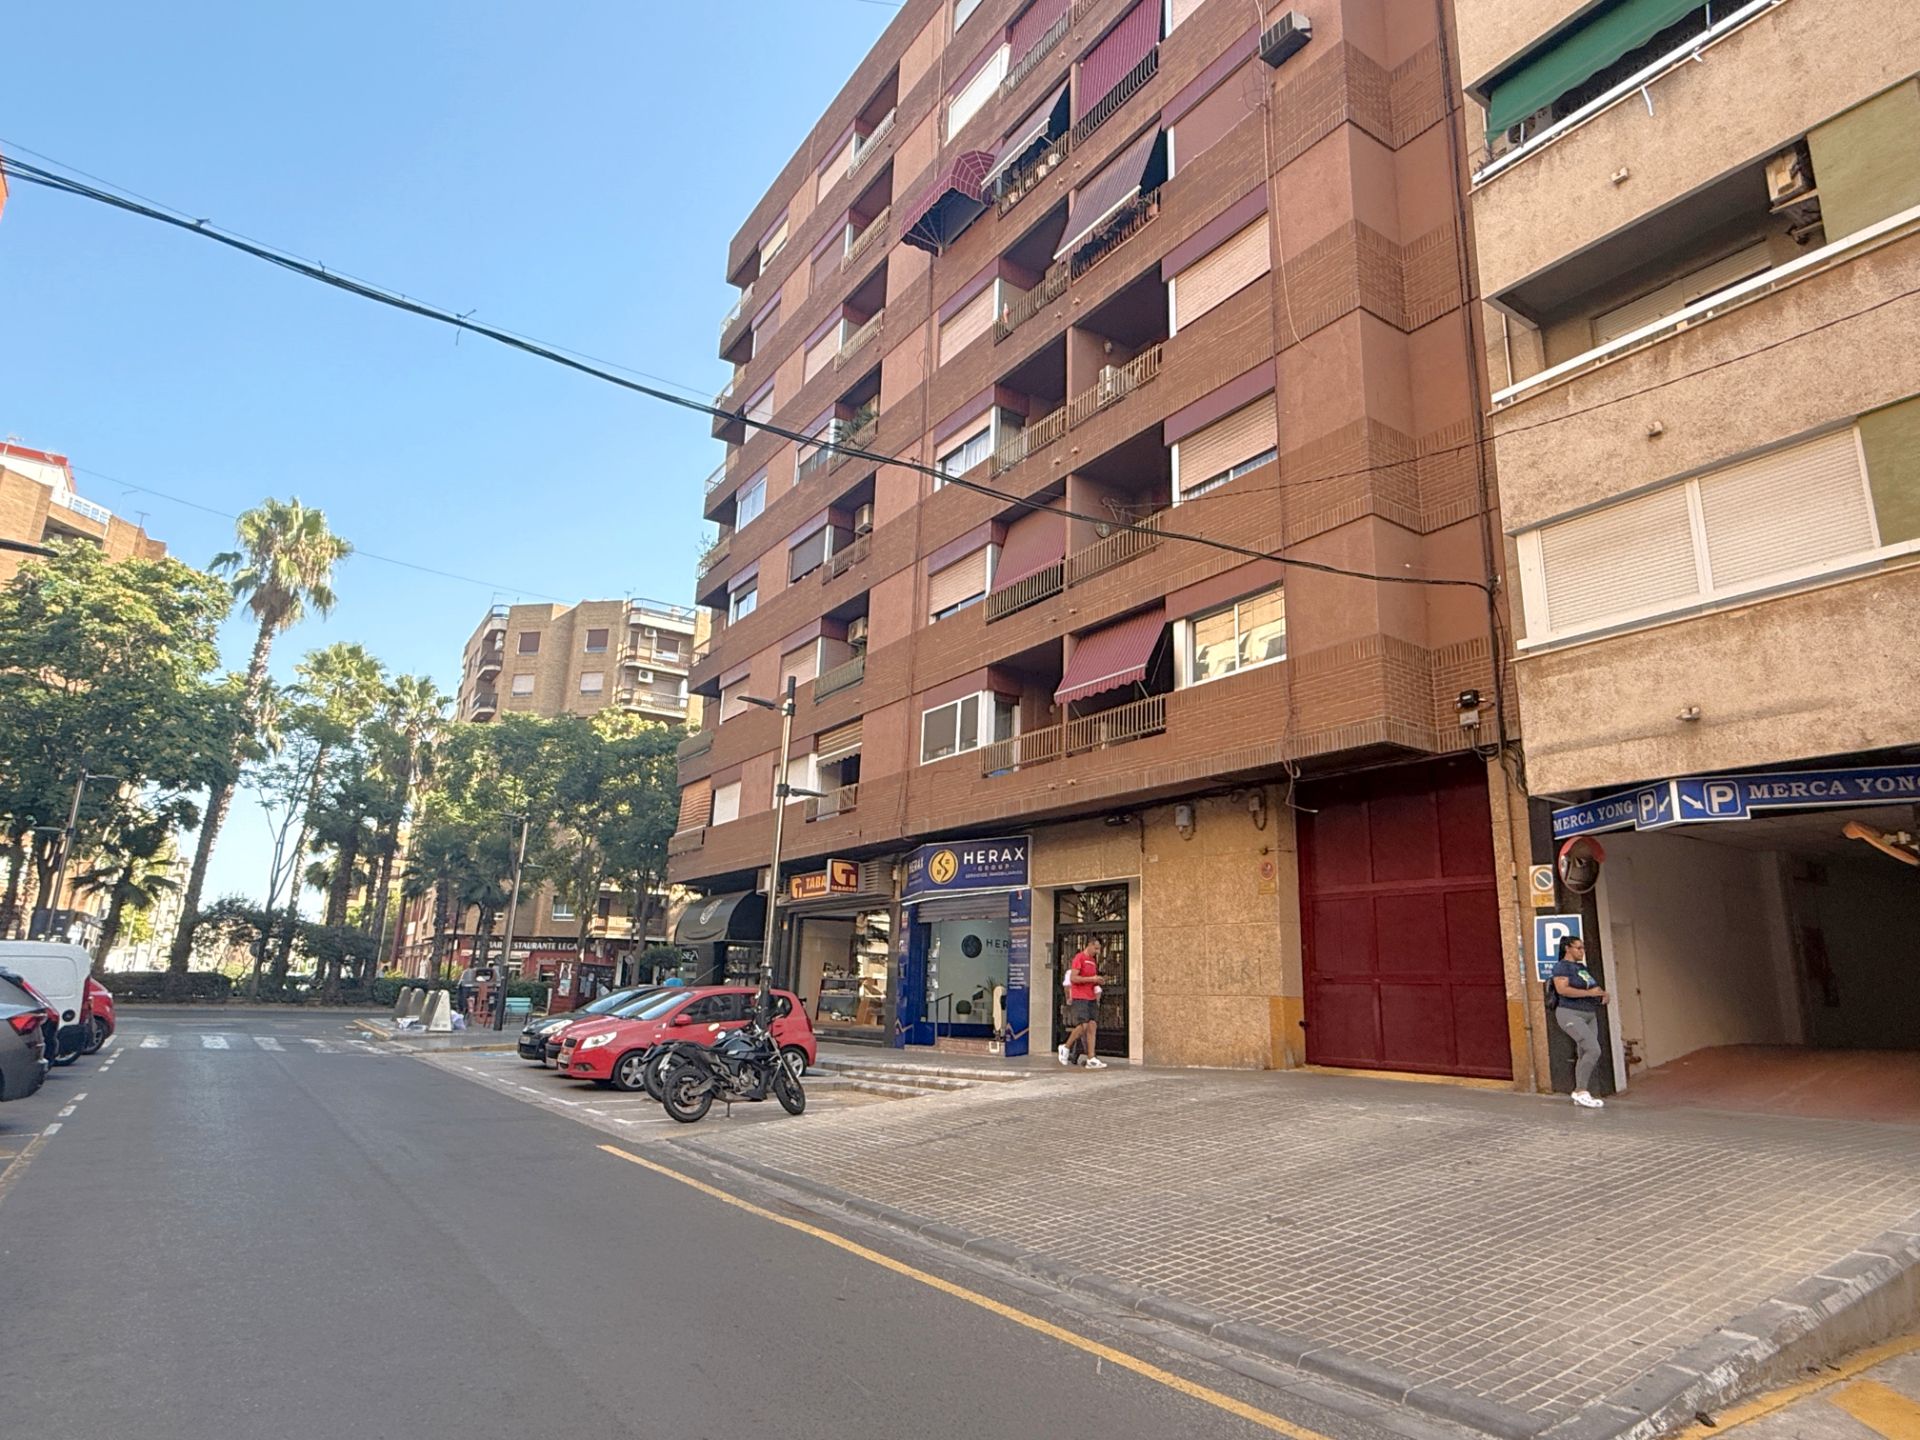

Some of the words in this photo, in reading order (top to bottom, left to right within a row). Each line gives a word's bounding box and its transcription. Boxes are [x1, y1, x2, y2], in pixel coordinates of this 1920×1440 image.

[1709, 785, 1735, 813] P
[1748, 780, 1847, 799] MERCA
[1855, 775, 1920, 794] YON
[1552, 812, 1595, 832] MERCA
[1598, 800, 1633, 820] YONG
[1639, 793, 1655, 821] P
[963, 847, 1025, 865] HERAX
[805, 874, 827, 890] TABA
[513, 941, 556, 950] STAURANTE
[985, 939, 1008, 949] HER
[1544, 922, 1570, 957] P
